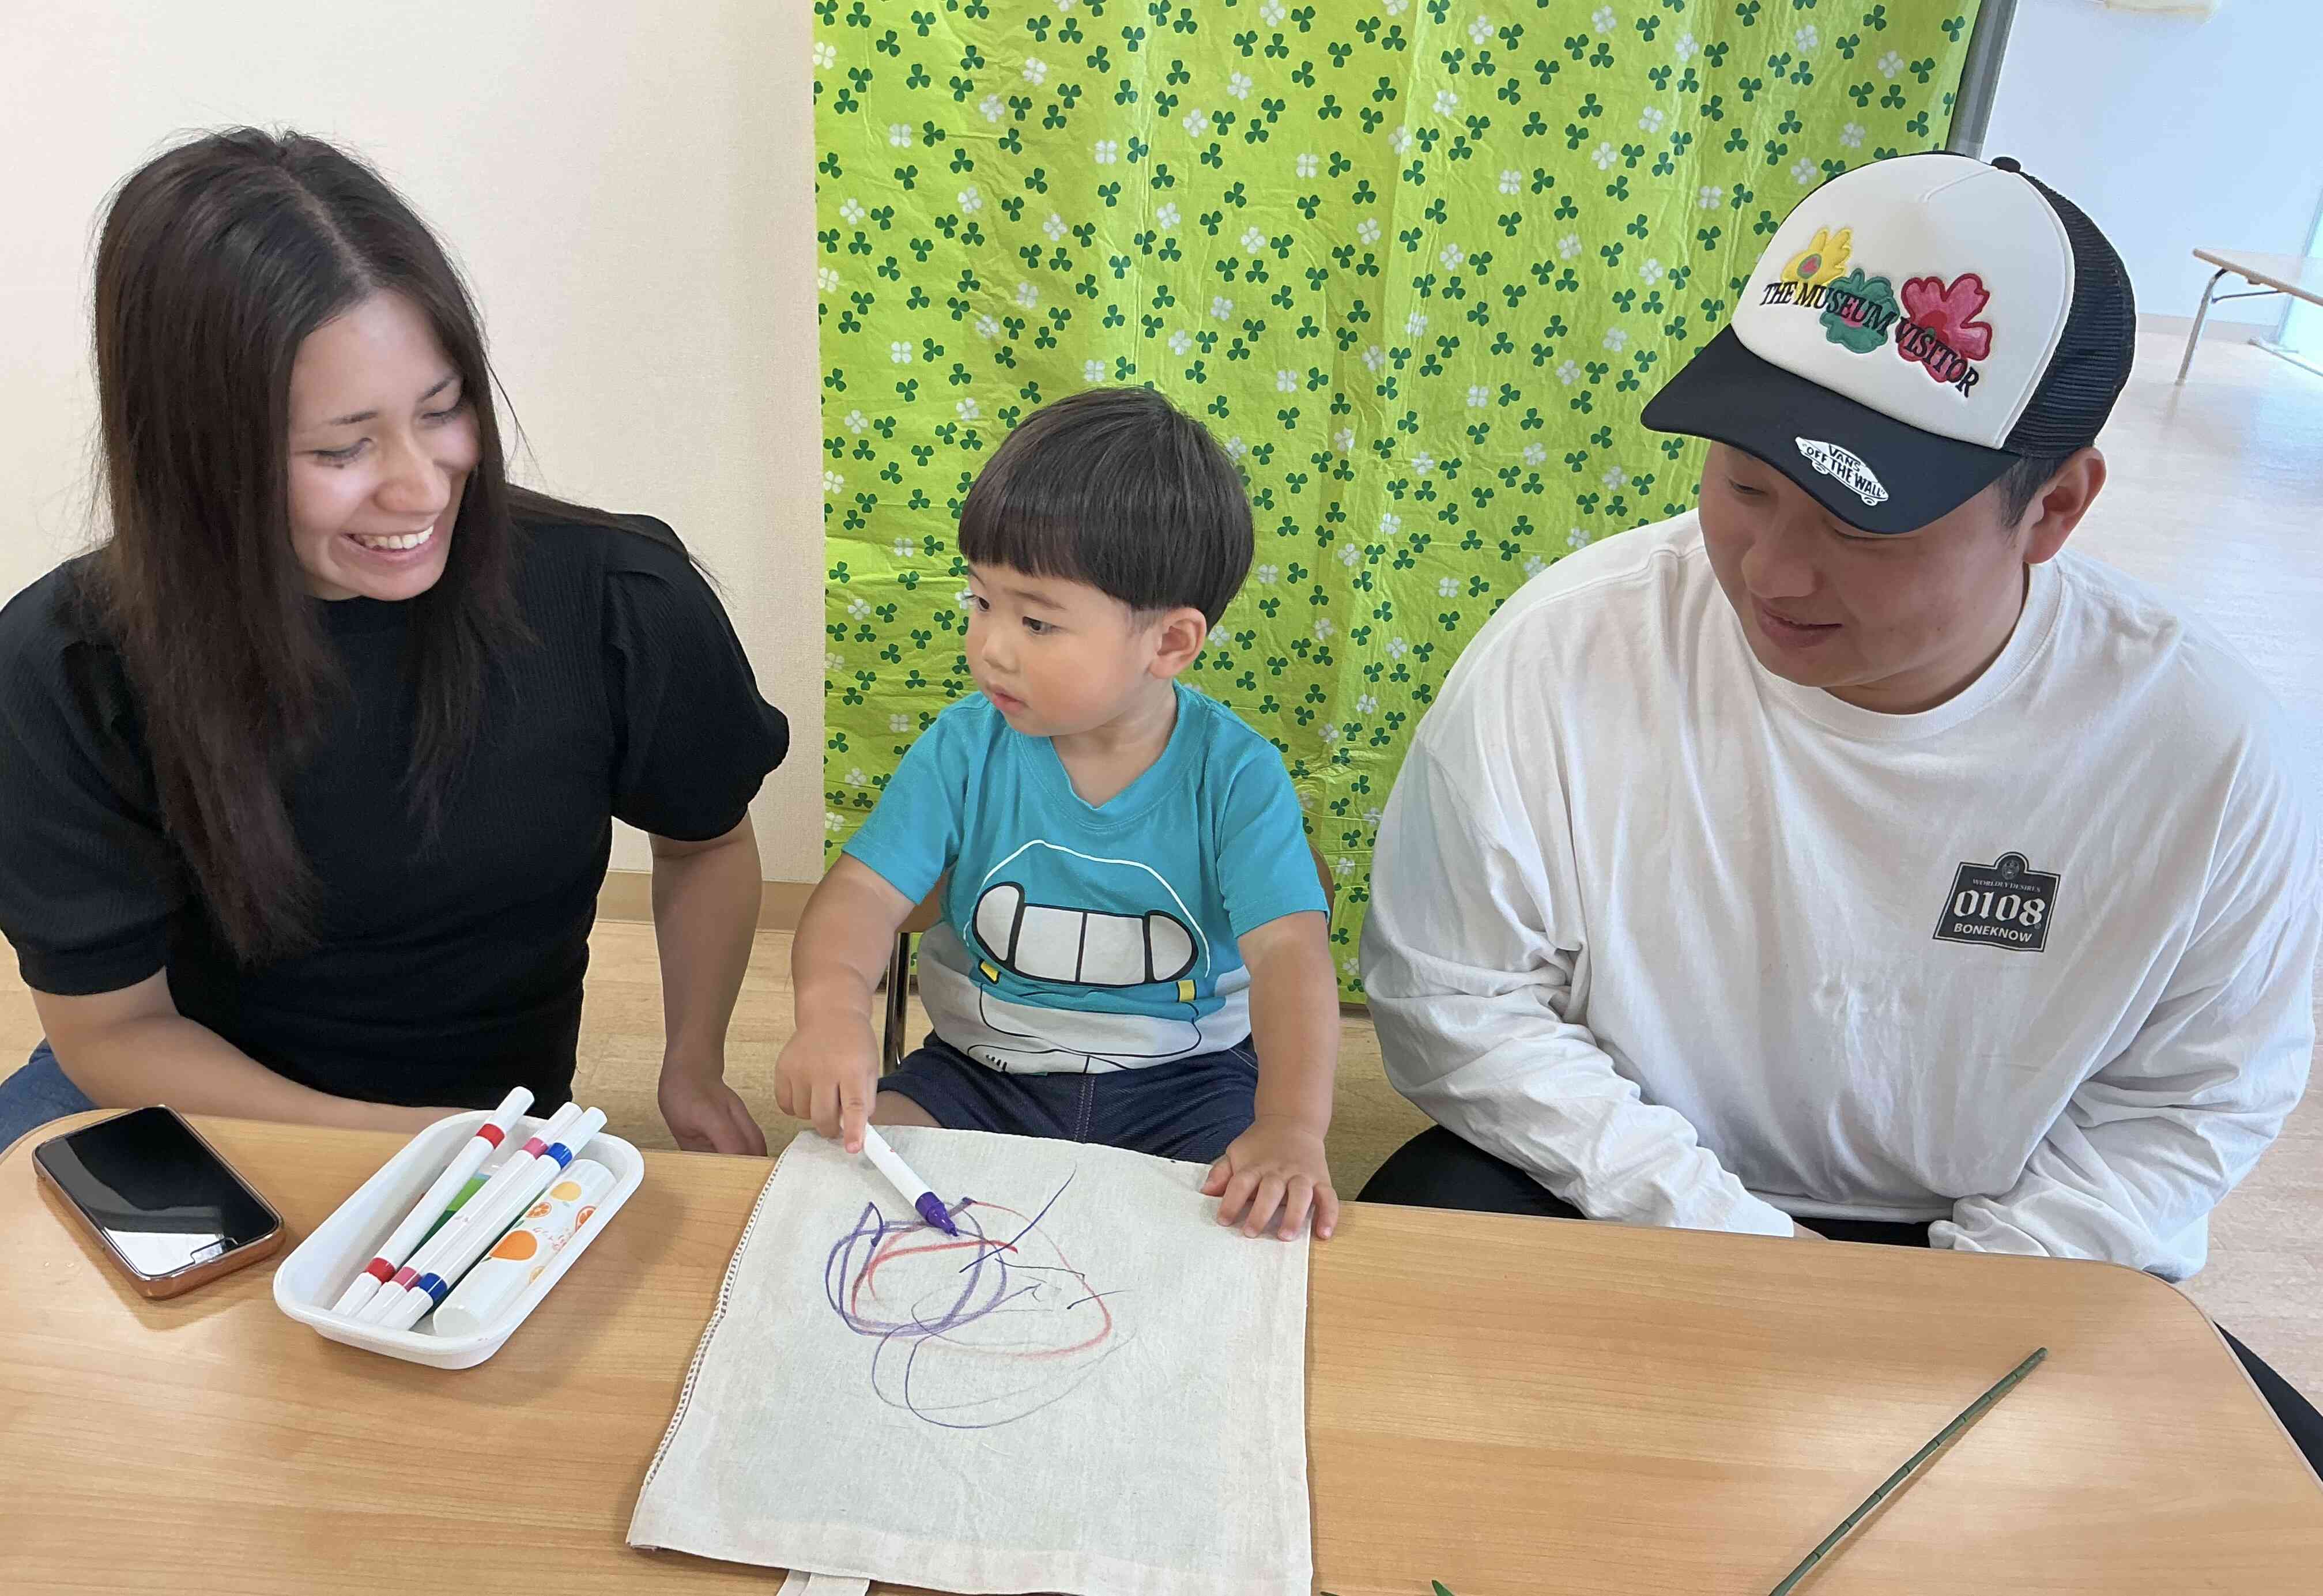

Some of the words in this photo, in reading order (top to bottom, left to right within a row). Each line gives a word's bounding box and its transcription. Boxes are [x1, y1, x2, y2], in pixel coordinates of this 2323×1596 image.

[1759, 281, 1798, 307] THE
[1793, 282, 1898, 337] MUSEUM
[1895, 316, 1979, 398] VISITOR
[1828, 443, 1861, 472] VANS
[1830, 459, 1854, 484] THE
[1973, 878, 2009, 888] WORLDLY
[2009, 882, 2041, 893] DESIRES
[1953, 889, 2046, 926] 0108
[1954, 923, 2032, 942] BONEKNOW
